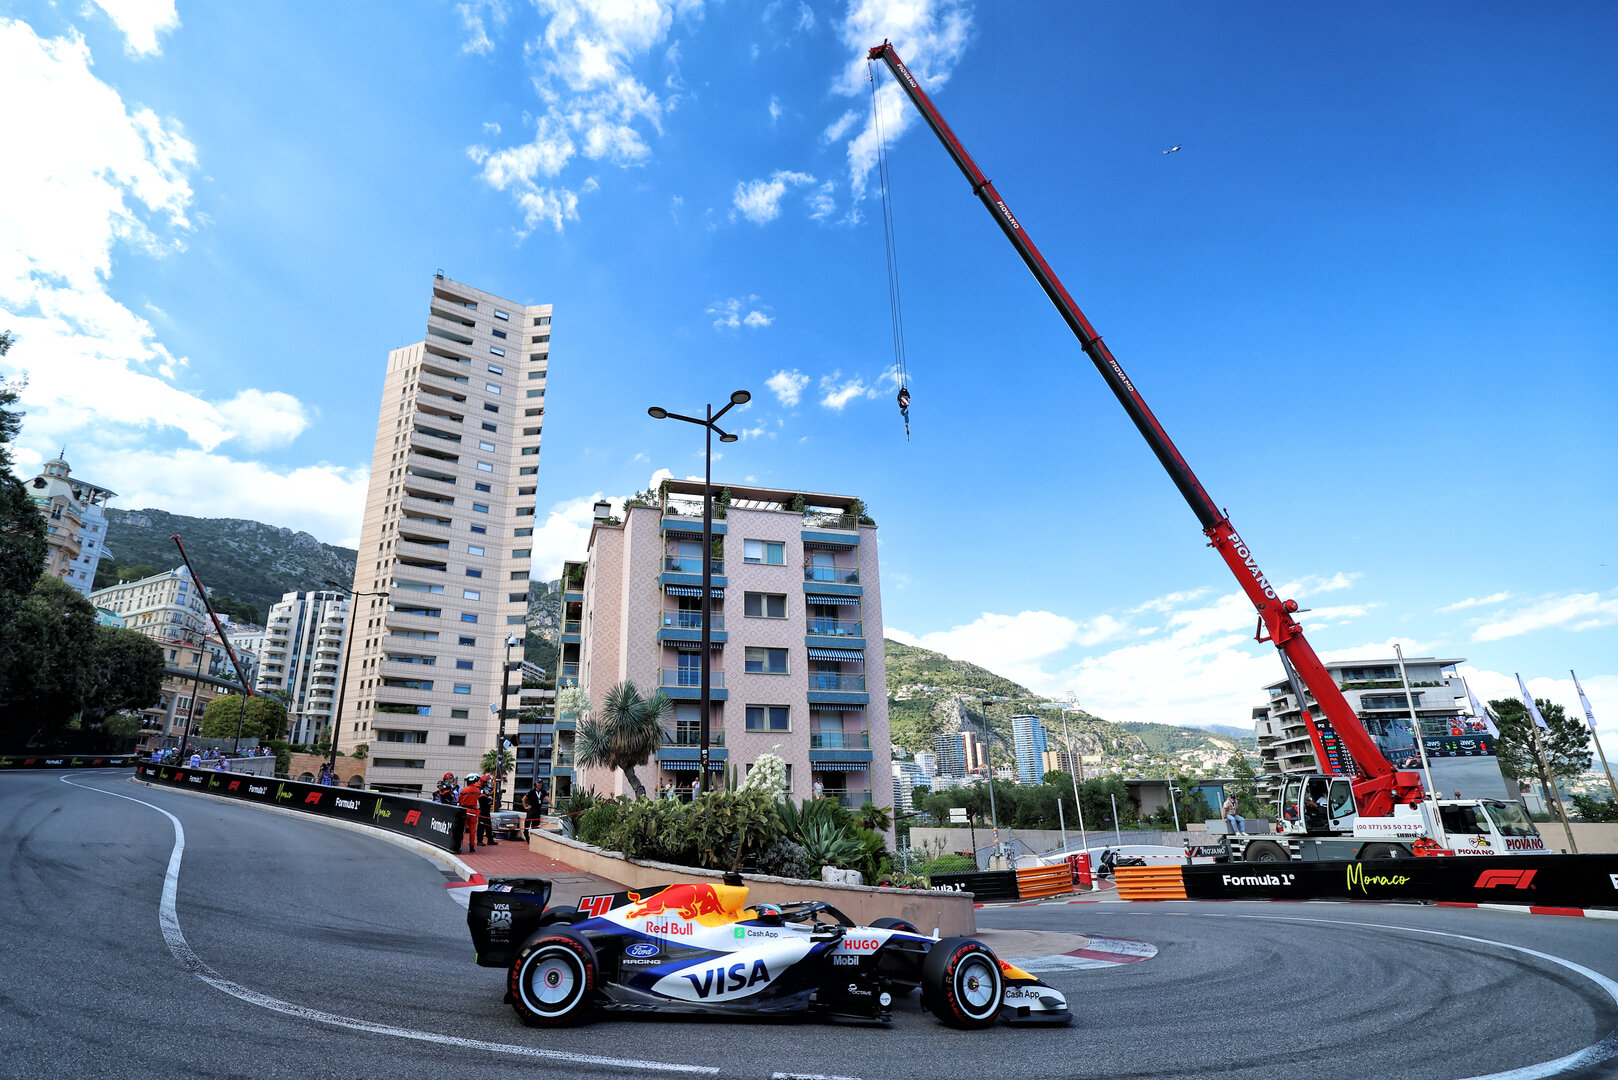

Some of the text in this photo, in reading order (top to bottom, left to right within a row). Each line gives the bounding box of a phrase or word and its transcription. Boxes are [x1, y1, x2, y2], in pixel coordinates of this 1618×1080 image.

[896, 63, 917, 88] PIOVANO
[996, 200, 1020, 229] PIOVANO
[1109, 360, 1134, 392] PIOVANO
[1227, 532, 1276, 600] PIOVANO
[248, 784, 263, 794] Formula
[335, 797, 355, 809] Formula
[403, 809, 422, 826] F1
[430, 817, 446, 834] Formula
[1505, 838, 1544, 850] PIOVANO
[1457, 848, 1495, 856] PIOVANO
[1222, 873, 1280, 886] Formula
[1346, 862, 1411, 894] Monaco
[1473, 869, 1538, 889] F1
[493, 903, 510, 911] VISA
[577, 895, 615, 919] 41
[645, 920, 693, 935] Red Bull
[747, 929, 764, 937] Cash
[631, 944, 653, 955] Ford
[844, 939, 879, 950] HUGO
[833, 955, 859, 966] Mobil
[952, 944, 976, 965] ZERO
[681, 959, 771, 998] VISA
[1005, 989, 1040, 1000] Cash App
